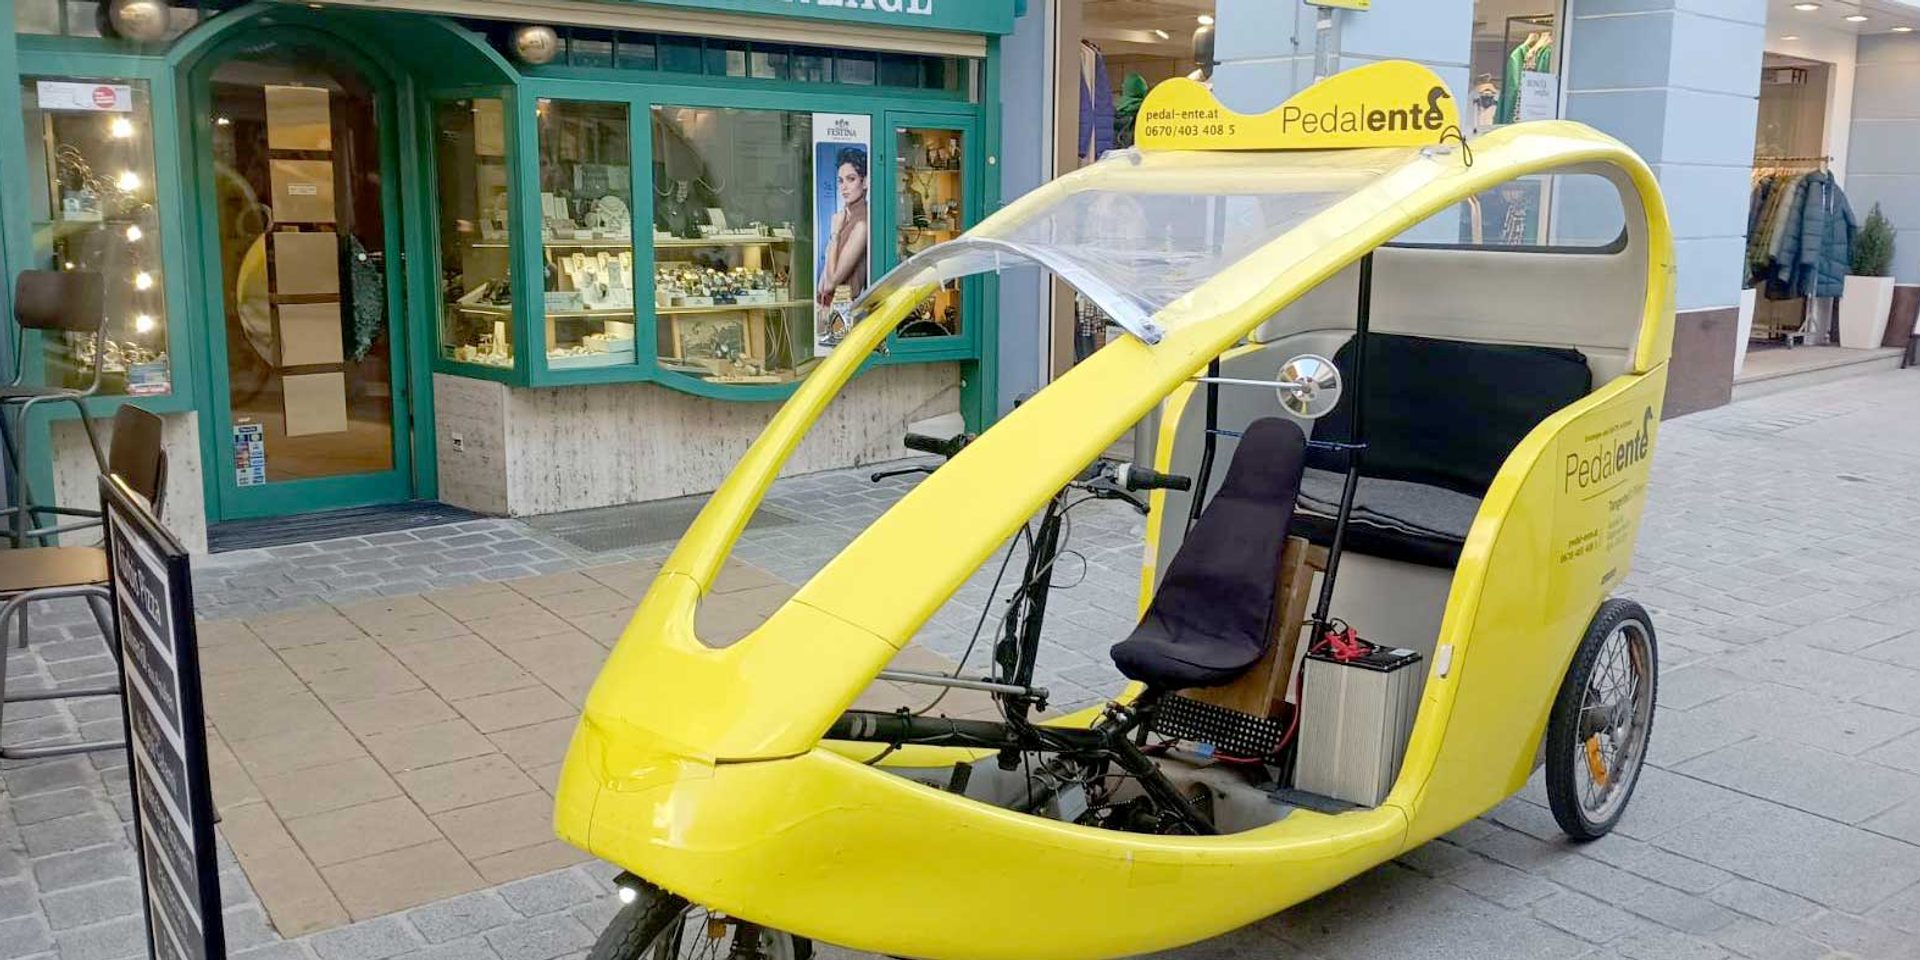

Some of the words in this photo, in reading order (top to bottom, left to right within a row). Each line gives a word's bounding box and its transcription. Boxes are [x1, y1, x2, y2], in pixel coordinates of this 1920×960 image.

[1146, 107, 1219, 121] pedal-ente.at
[1282, 103, 1444, 134] Pedalente
[1145, 125, 1198, 137] 0670/403
[1202, 125, 1224, 135] 408
[1228, 124, 1235, 135] 5
[1564, 429, 1648, 495] Pedalente
